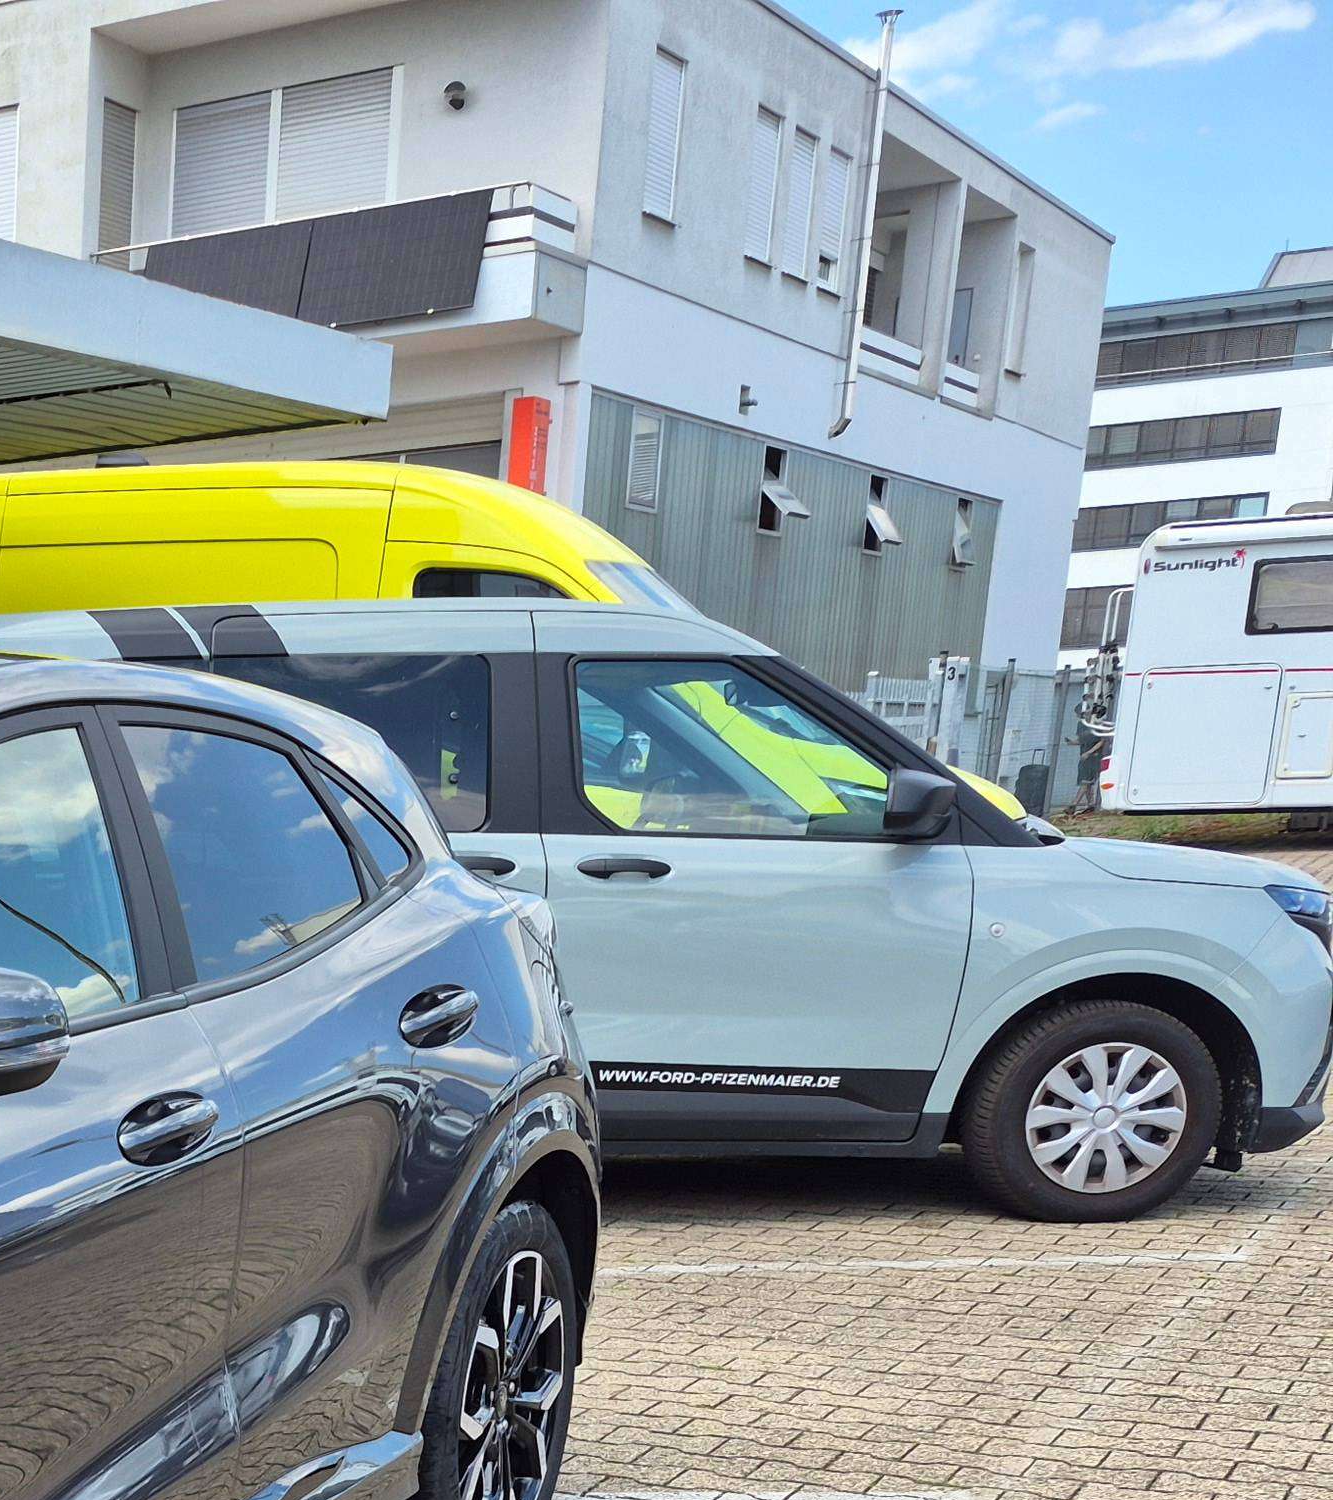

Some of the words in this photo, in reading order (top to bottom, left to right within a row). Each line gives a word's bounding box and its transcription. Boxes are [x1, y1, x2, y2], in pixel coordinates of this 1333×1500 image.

[1153, 557, 1239, 573] Sunlight
[947, 666, 956, 681] 3
[598, 1069, 841, 1089] WWW.FORD-PFIZENMAIER.DE
